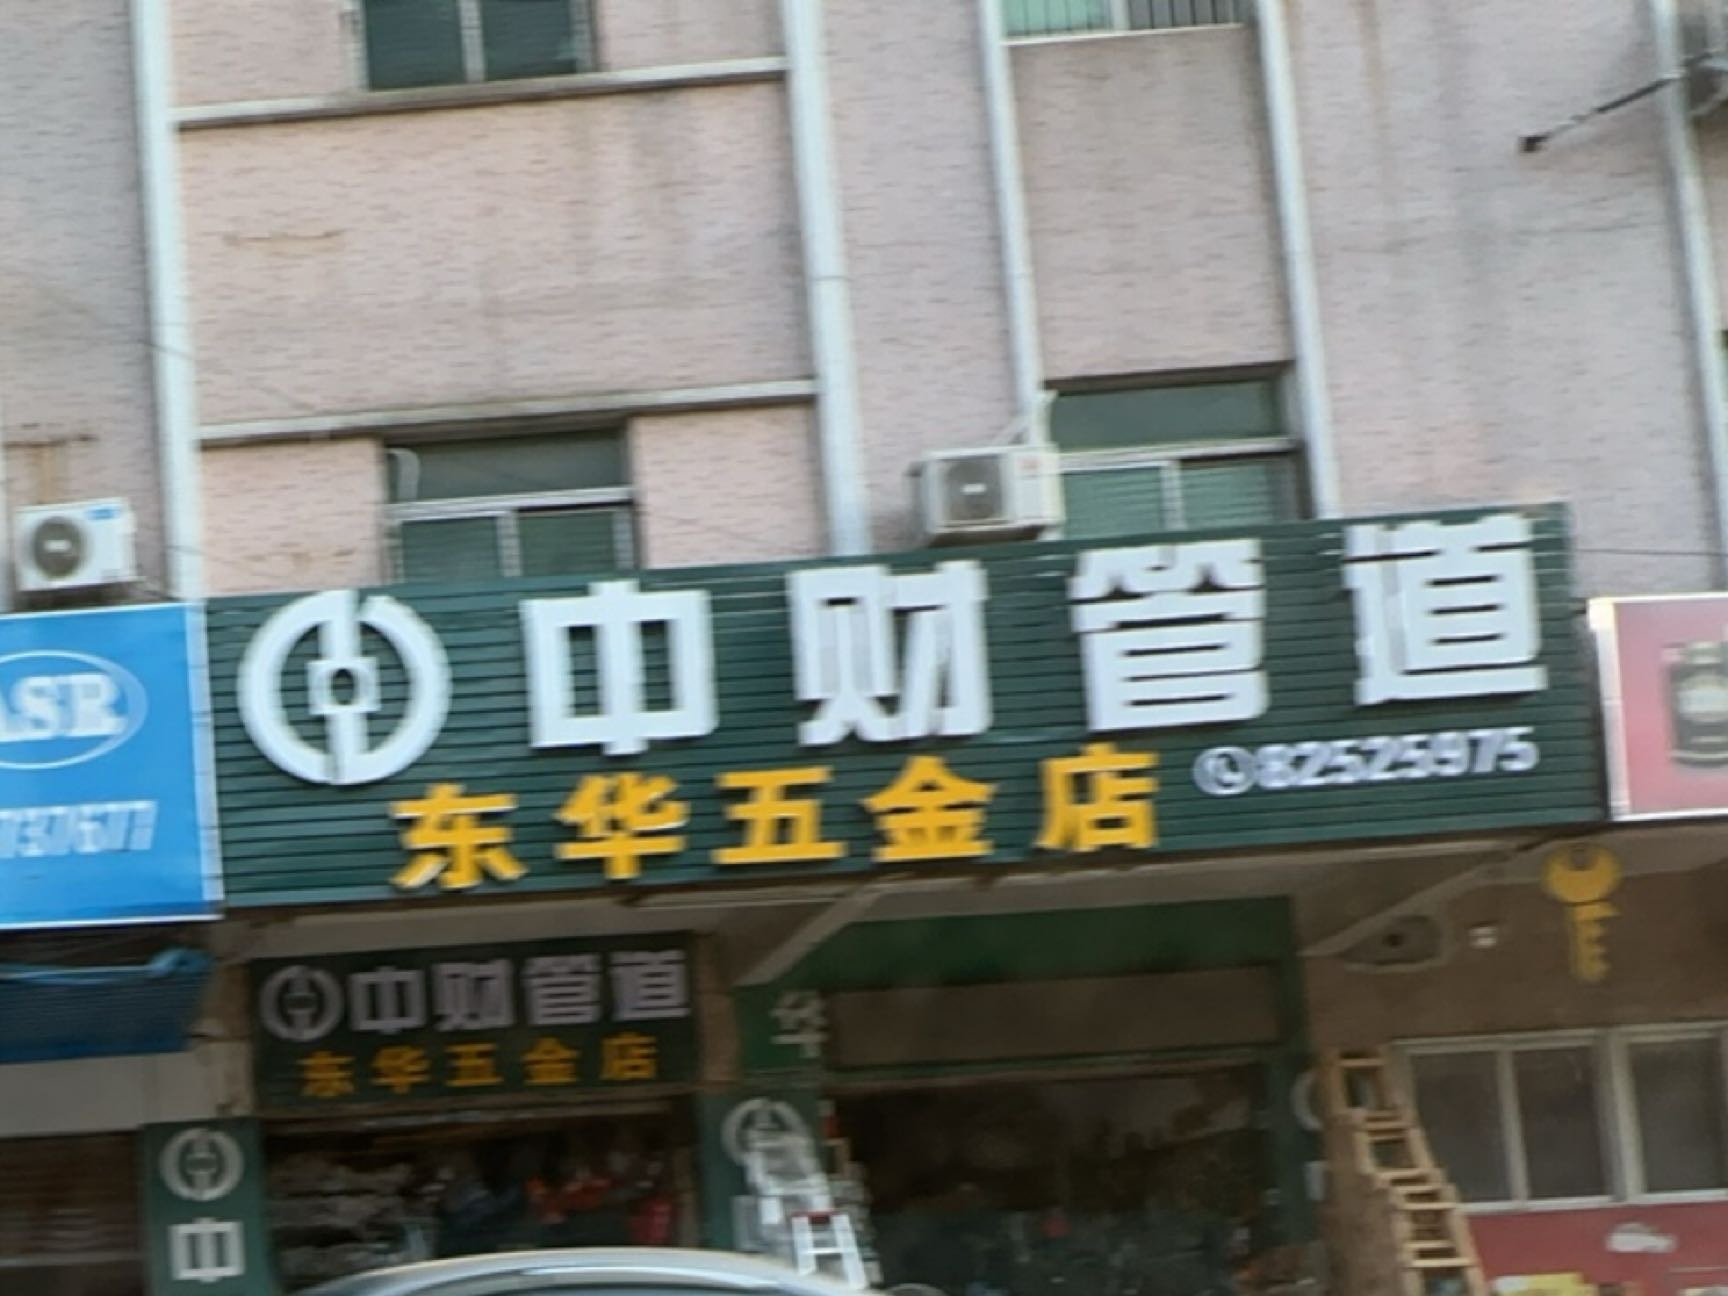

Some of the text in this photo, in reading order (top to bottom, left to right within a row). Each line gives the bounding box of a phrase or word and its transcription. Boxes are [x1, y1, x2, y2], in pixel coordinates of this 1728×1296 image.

[519, 513, 1549, 755] 中财管道
[1254, 726, 1539, 790] 82525975
[389, 742, 1160, 890] 东华五金店
[348, 950, 691, 1034] 中财管道
[297, 1032, 659, 1096] 东华五金店
